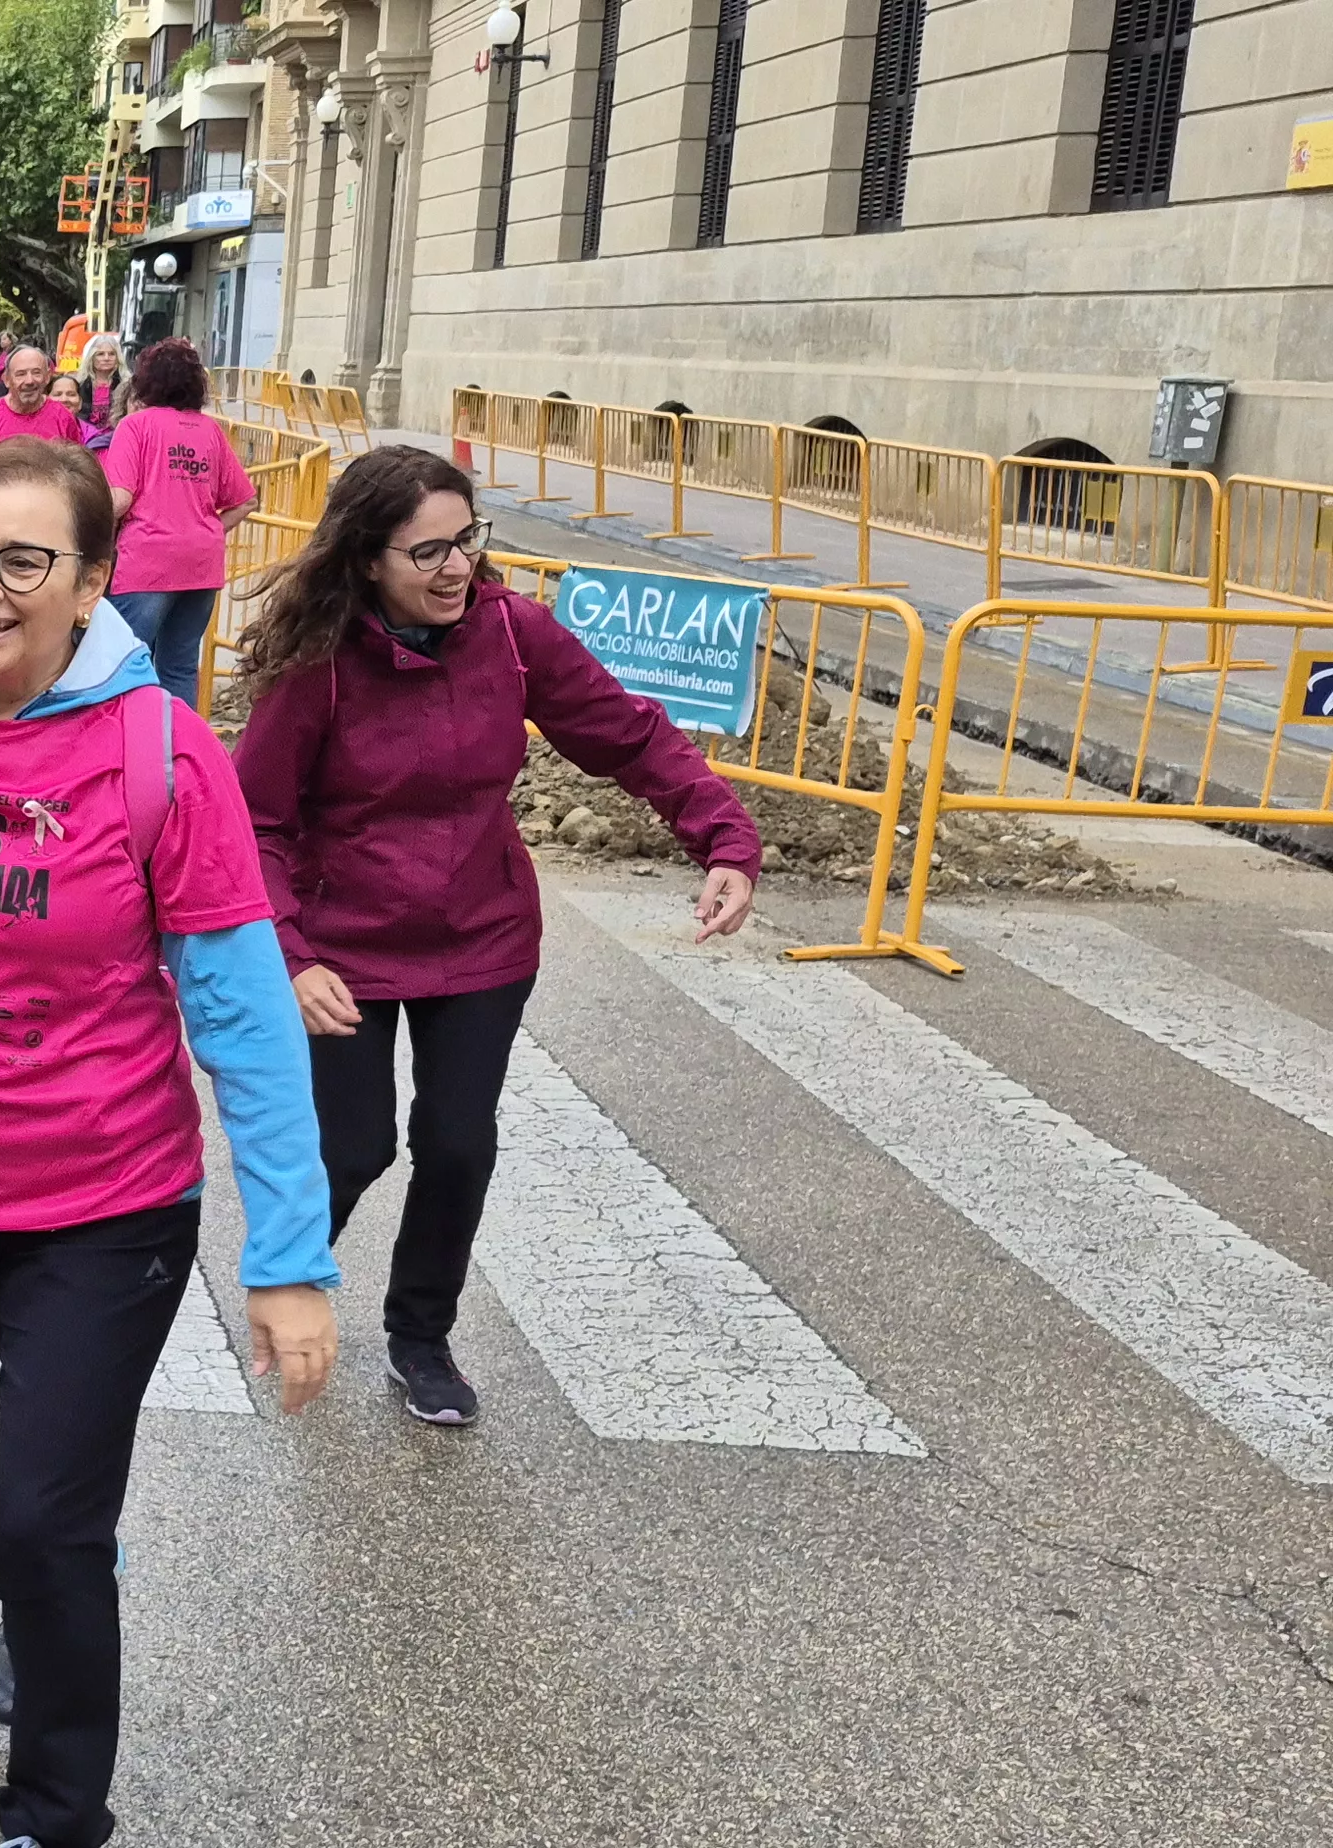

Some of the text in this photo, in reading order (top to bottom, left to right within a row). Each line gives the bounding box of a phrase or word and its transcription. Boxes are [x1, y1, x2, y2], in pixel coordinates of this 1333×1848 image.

[167, 443, 196, 459] alto
[568, 580, 750, 648] GARLAN
[634, 638, 740, 671] INMOBILIARIOS
